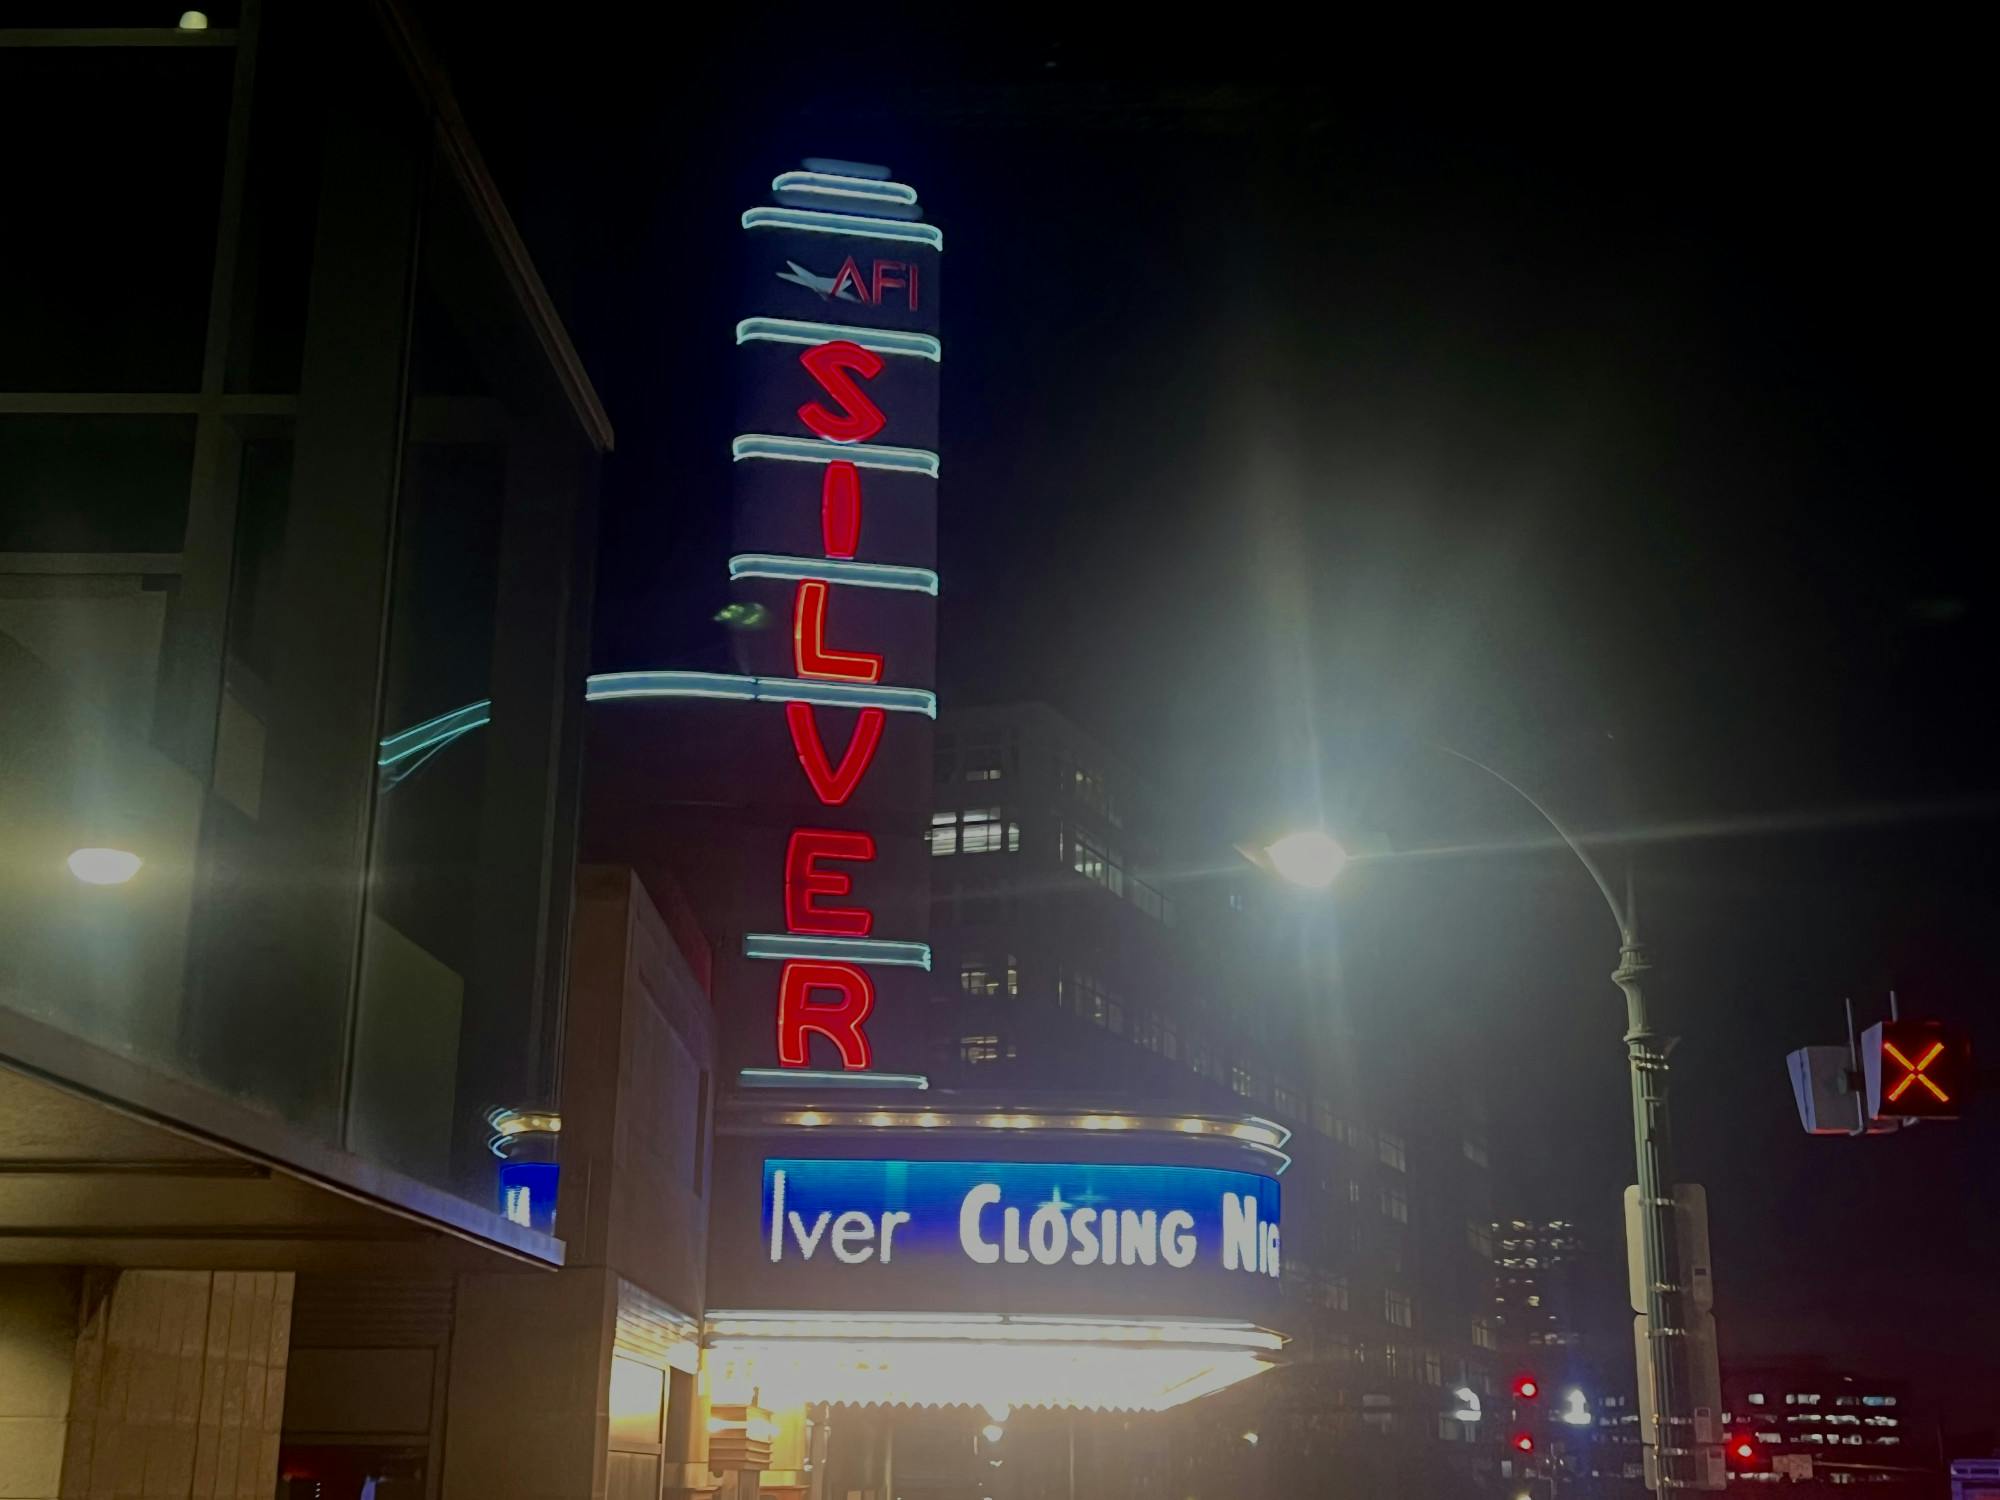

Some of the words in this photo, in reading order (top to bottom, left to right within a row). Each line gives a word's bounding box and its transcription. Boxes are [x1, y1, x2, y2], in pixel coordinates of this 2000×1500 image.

[829, 255, 919, 312] AFI
[777, 340, 887, 1071] SILVER
[959, 1183, 1198, 1269] CLOSING
